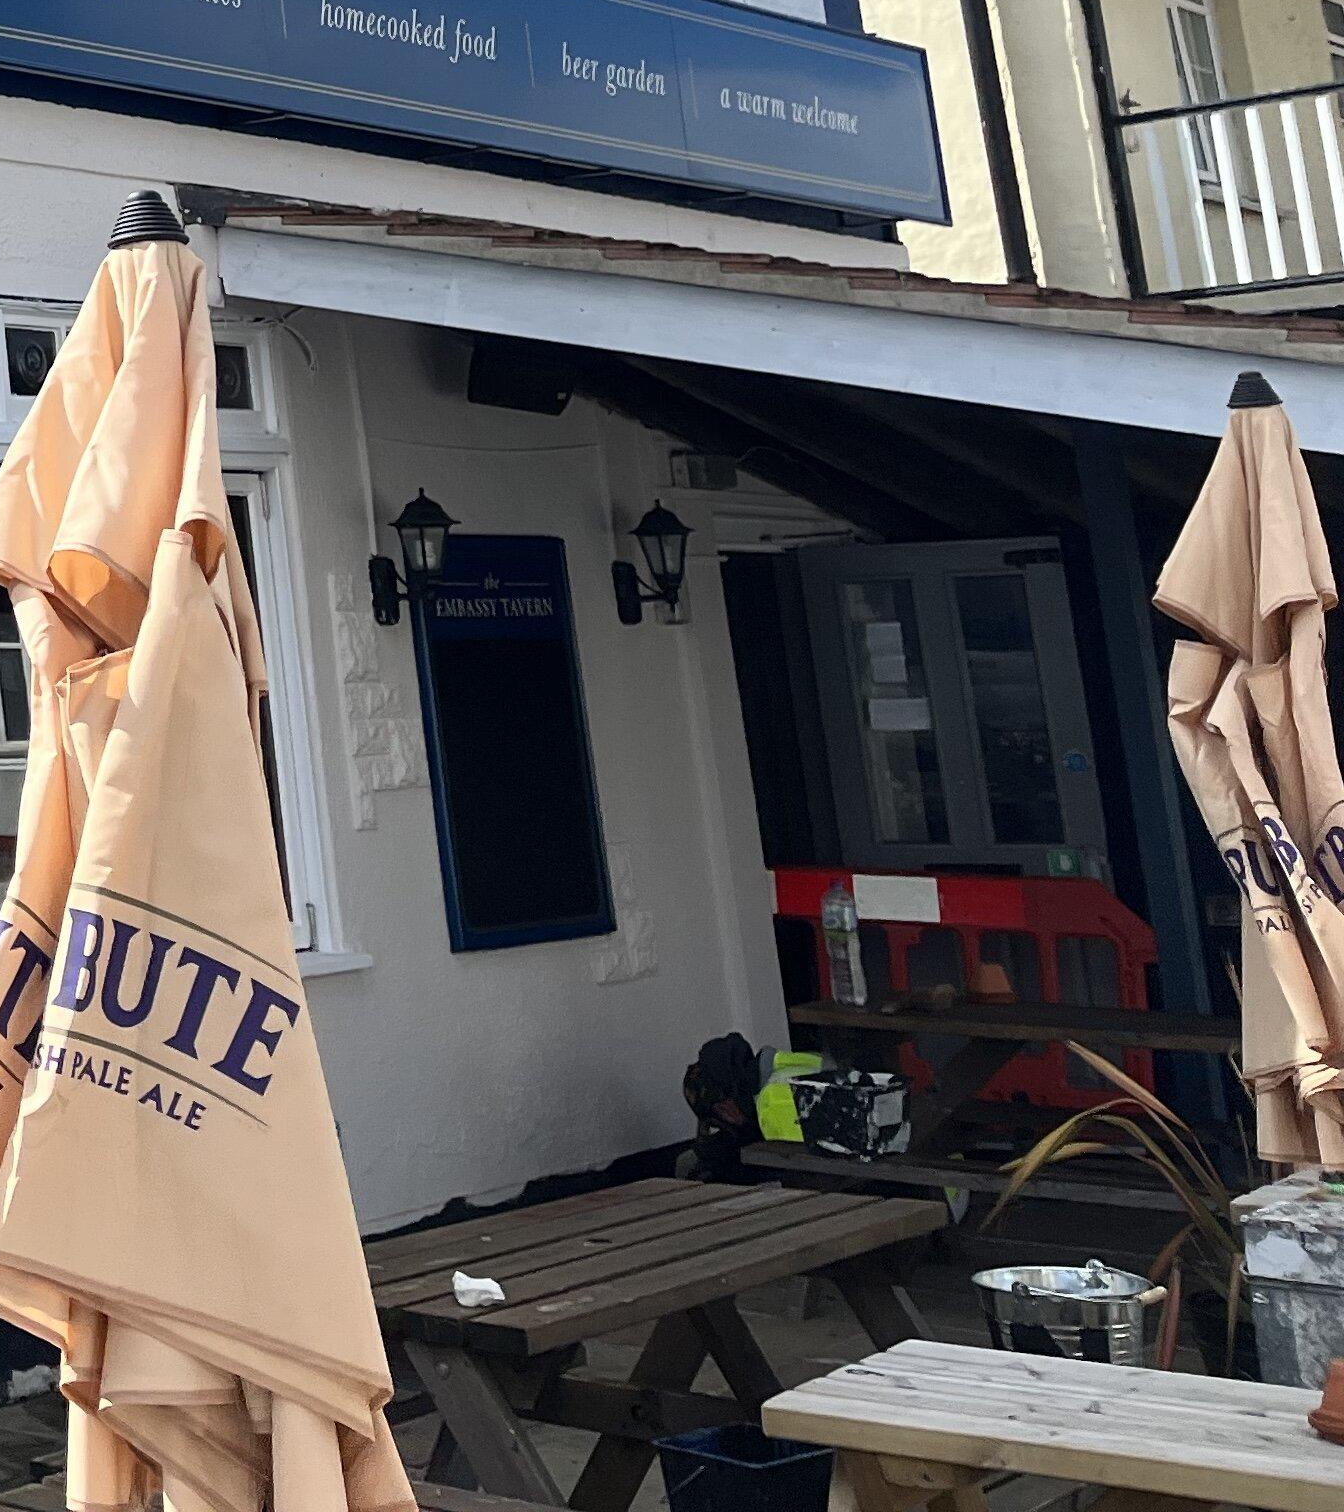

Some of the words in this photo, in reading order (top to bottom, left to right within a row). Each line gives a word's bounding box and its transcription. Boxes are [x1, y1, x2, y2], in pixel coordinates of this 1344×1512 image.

[449, 19, 496, 63] food
[561, 39, 599, 80] beer
[606, 60, 665, 96] garden
[719, 87, 731, 110] a
[737, 92, 785, 119] warm
[792, 96, 857, 133] welcome
[436, 598, 497, 617] EMBASSY
[500, 597, 554, 617] TAVERN
[70, 1050, 132, 1097] PALE
[139, 1083, 208, 1131] ALE
